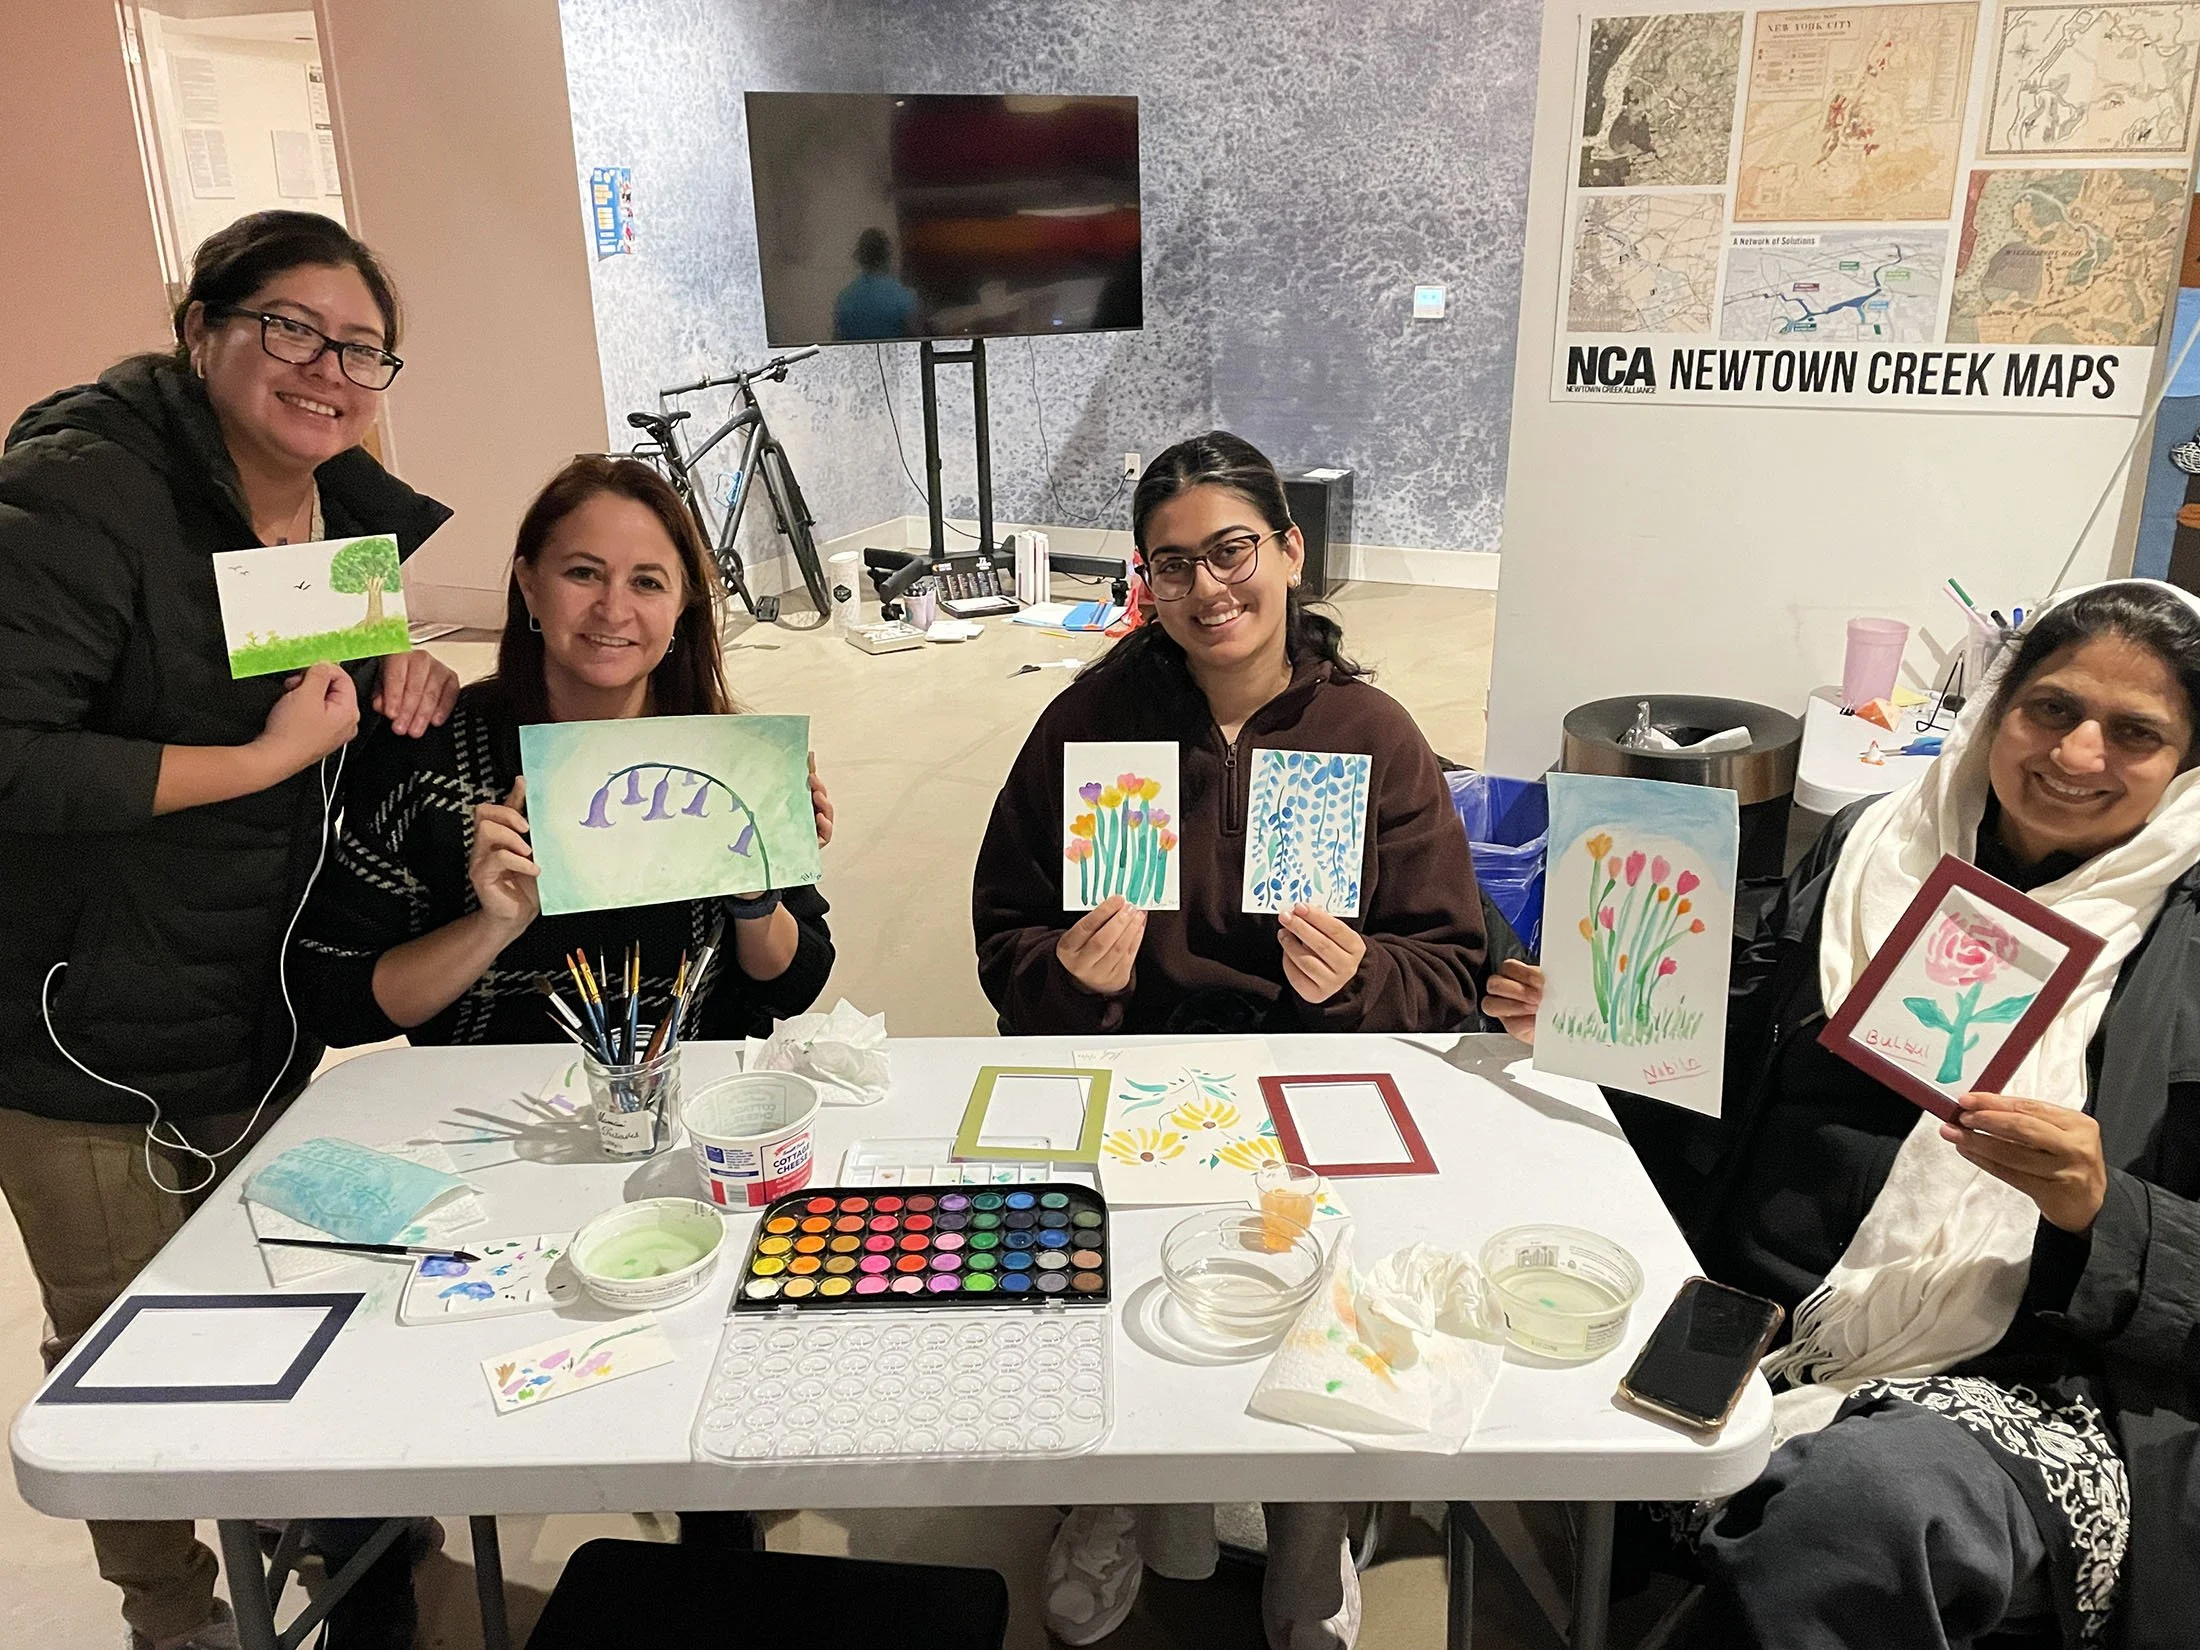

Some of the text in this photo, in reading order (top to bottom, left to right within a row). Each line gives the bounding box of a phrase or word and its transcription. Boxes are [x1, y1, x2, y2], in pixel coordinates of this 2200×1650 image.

[1827, 20, 1852, 29] CITY
[1739, 237, 1770, 246] Network
[1772, 237, 1780, 245] of
[1781, 236, 1816, 245] Solutions
[1566, 346, 1657, 387] NCA
[1669, 348, 2120, 399] NEWTOWN CREEK MAPS
[1601, 386, 1624, 394] CREEK
[1623, 386, 1657, 395] ALLIANCE
[773, 1142, 810, 1168] COTTAGE
[777, 1153, 808, 1174] CHEESE
